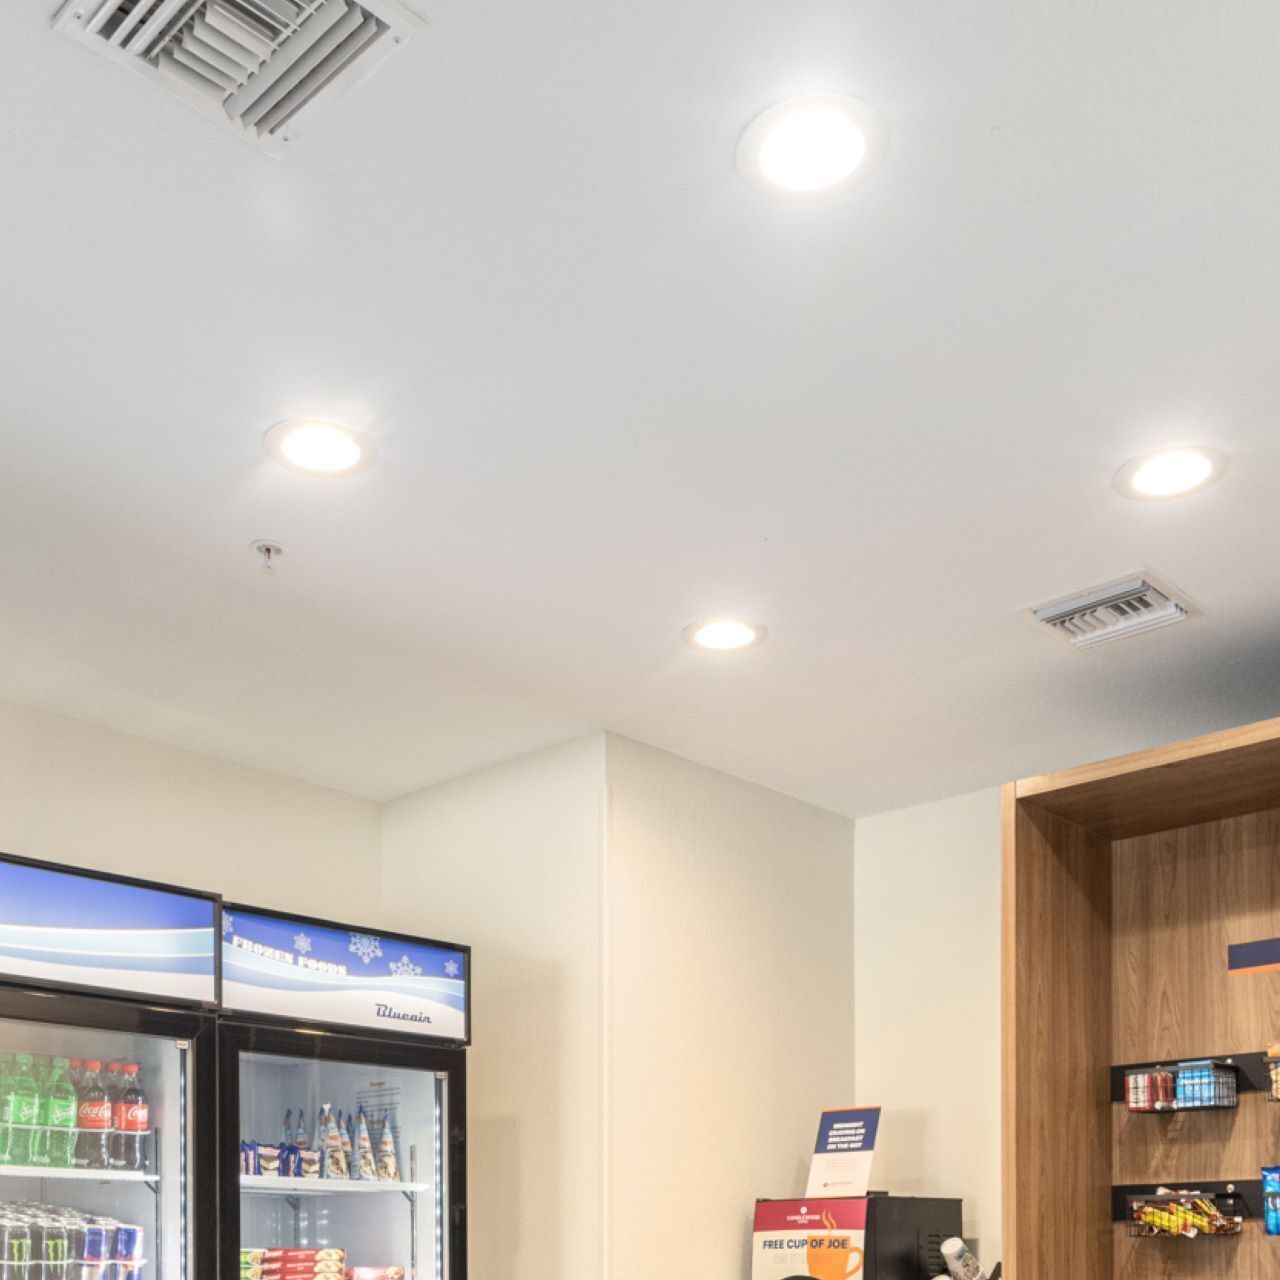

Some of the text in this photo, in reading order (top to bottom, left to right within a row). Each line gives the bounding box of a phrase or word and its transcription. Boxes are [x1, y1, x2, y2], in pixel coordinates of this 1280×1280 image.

[232, 934, 347, 976] FROZEN FOODS
[375, 1003, 432, 1024] Blueair
[763, 1239, 847, 1249] FREE CUP OF JOE
